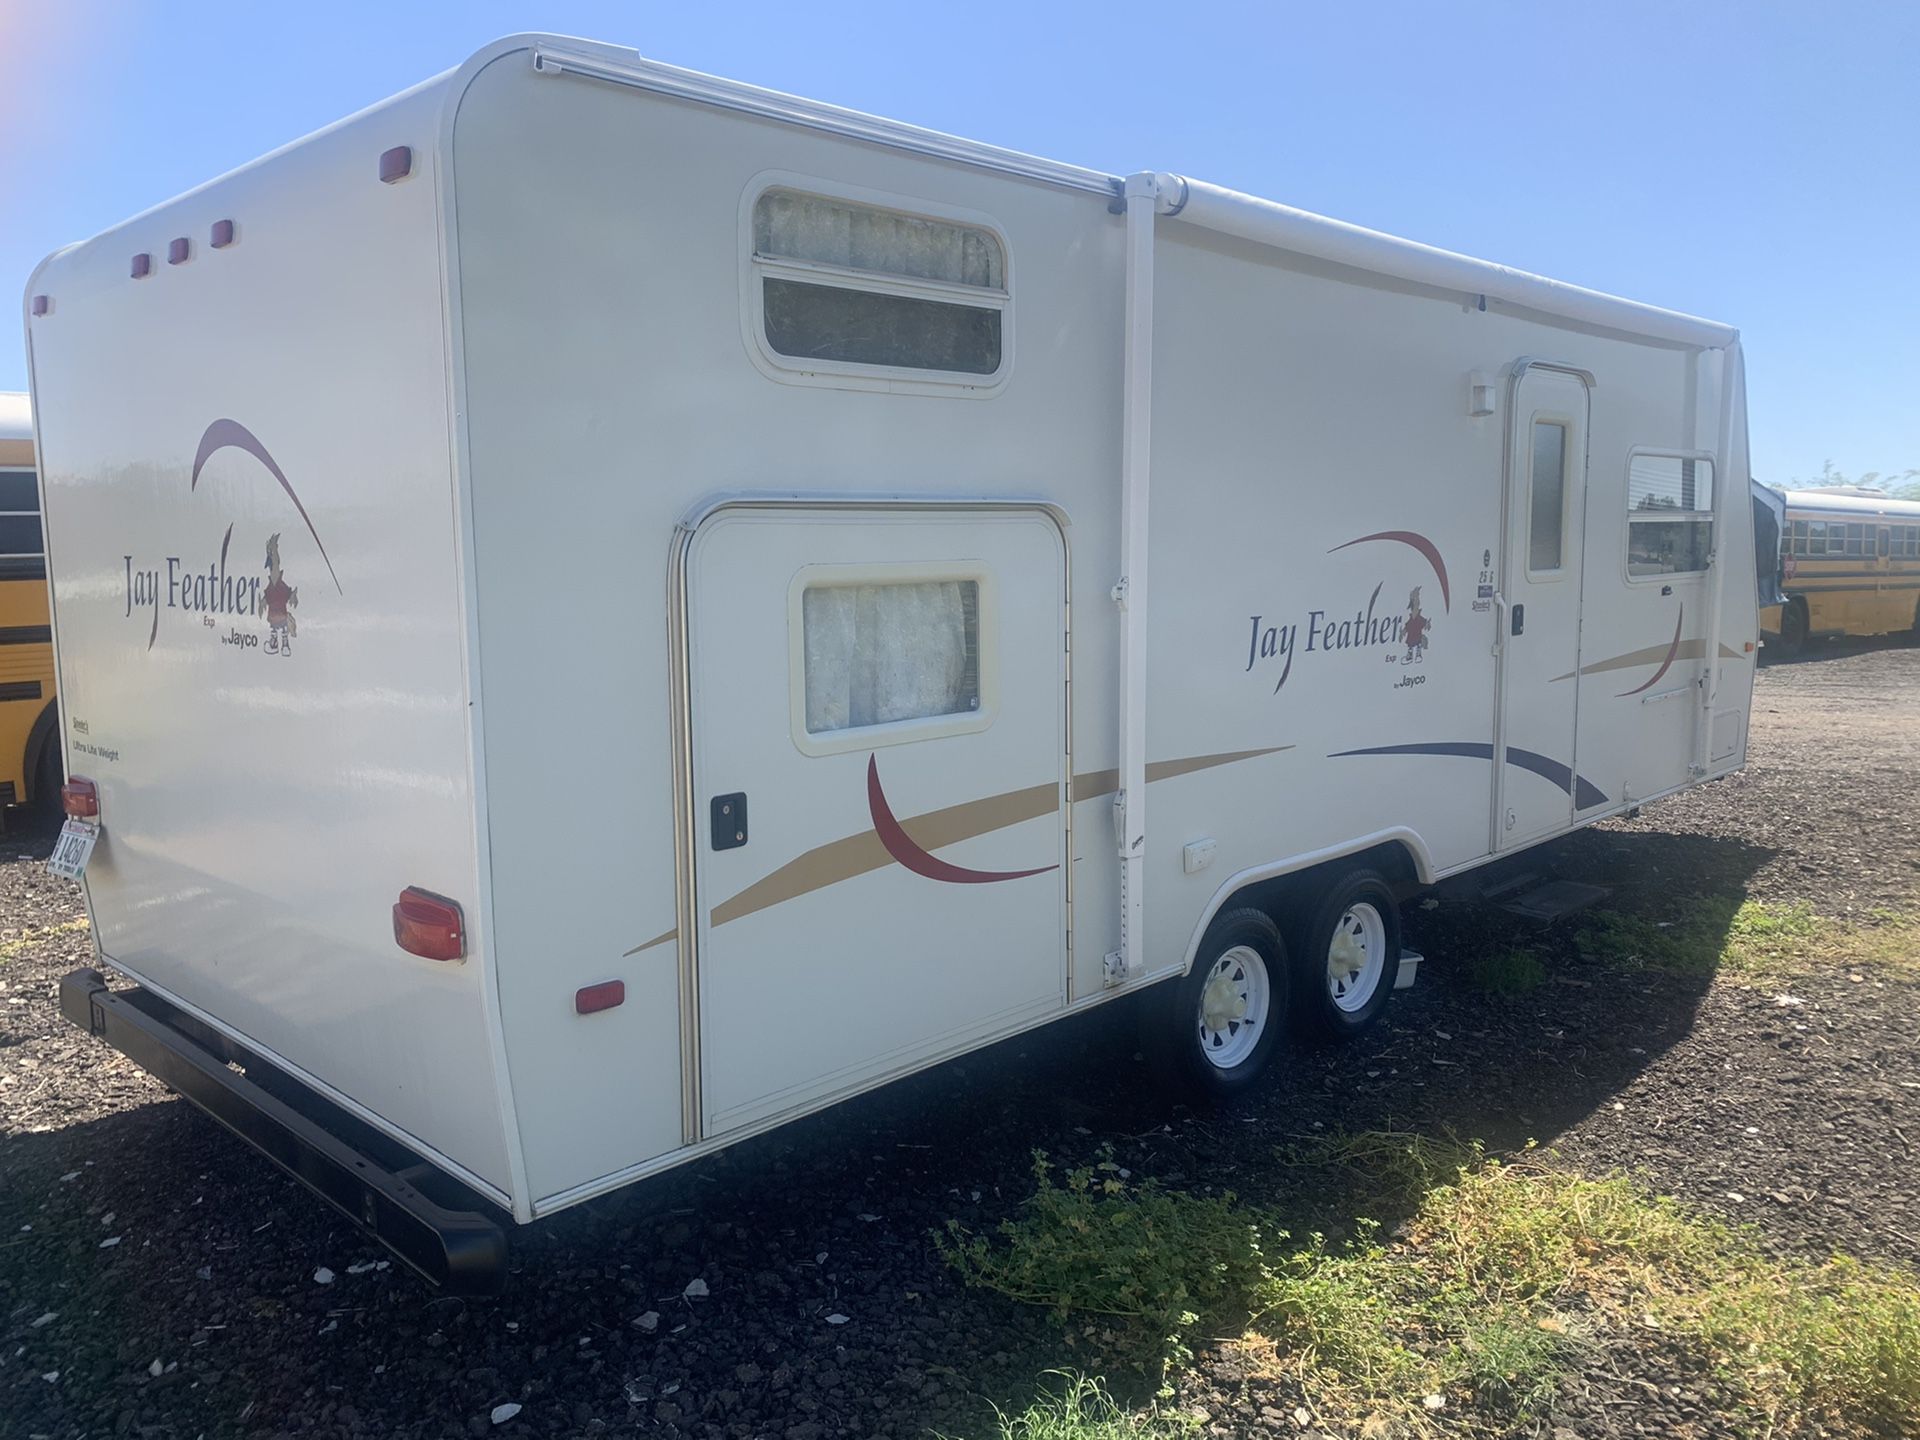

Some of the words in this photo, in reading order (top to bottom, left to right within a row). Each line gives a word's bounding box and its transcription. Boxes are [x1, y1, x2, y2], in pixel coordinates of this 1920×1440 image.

[124, 555, 159, 652] Jay
[166, 521, 260, 616] Feather
[228, 627, 258, 650] Jayco
[1245, 615, 1297, 696] Jay
[1304, 580, 1402, 652] Feather
[1400, 674, 1426, 689] Jayco
